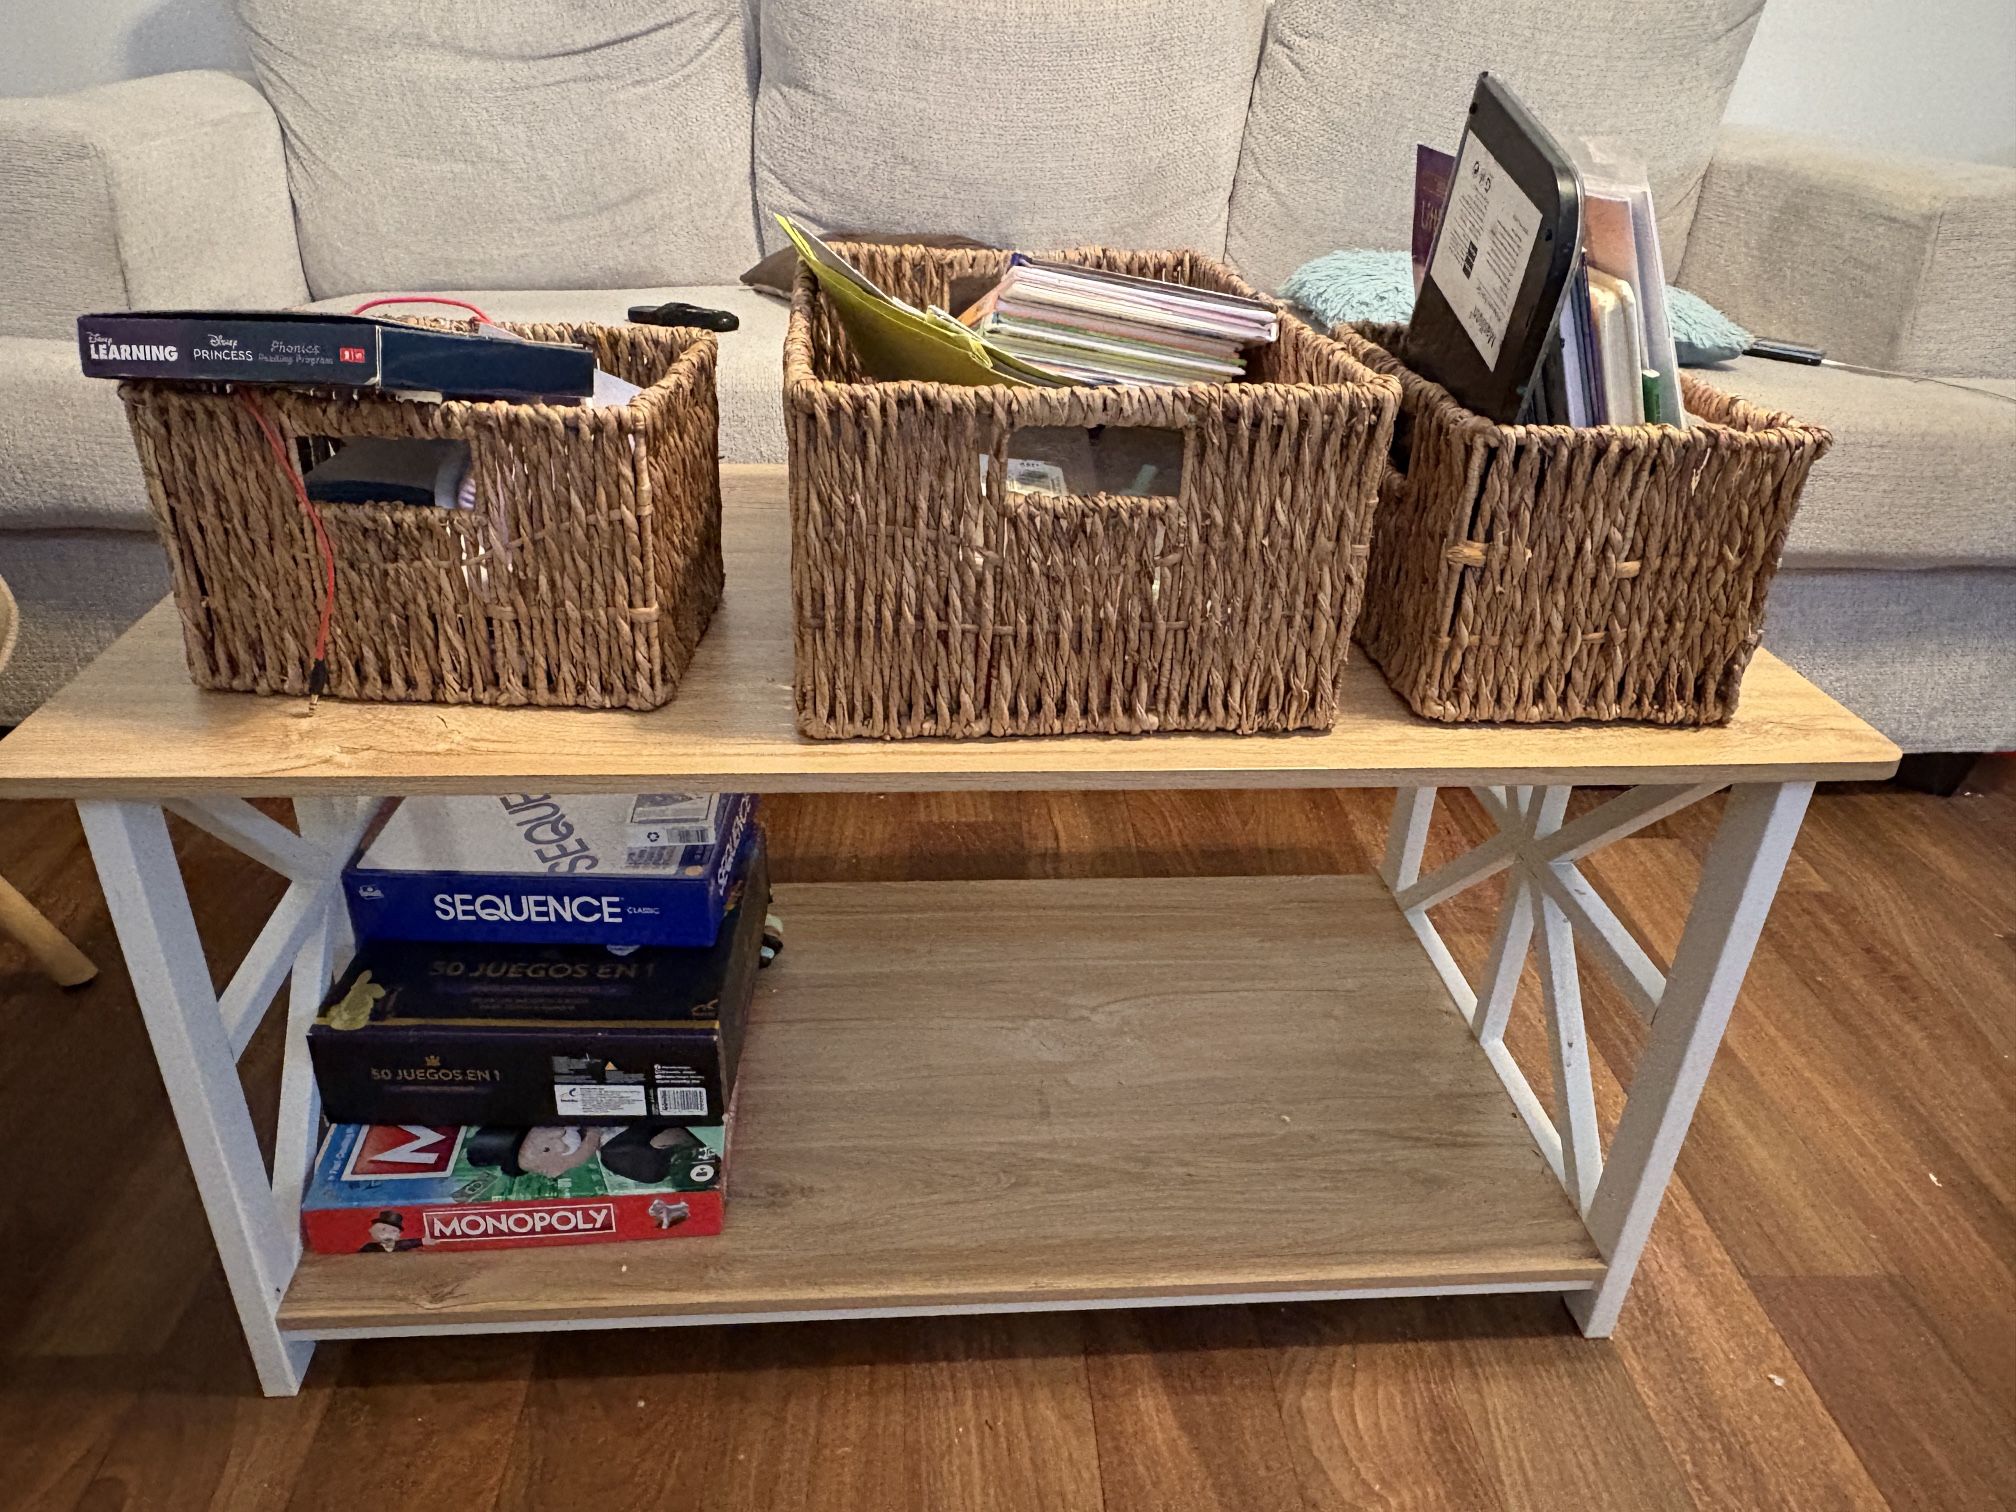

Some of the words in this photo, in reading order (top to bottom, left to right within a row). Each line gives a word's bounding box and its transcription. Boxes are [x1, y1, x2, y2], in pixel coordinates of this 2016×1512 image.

[86, 331, 113, 346] Disney
[208, 334, 238, 349] Disney
[90, 343, 179, 361] LEARNING
[193, 348, 253, 361] PRINCESS
[271, 340, 320, 354] Phonics
[433, 894, 624, 923] SEQUENCE
[428, 961, 465, 976] 50
[469, 962, 592, 978] JUEGOS
[596, 963, 641, 979] EN
[396, 1068, 464, 1081] JUEGOS
[467, 1069, 491, 1081] EN
[433, 1208, 608, 1237] MONOPOLY
